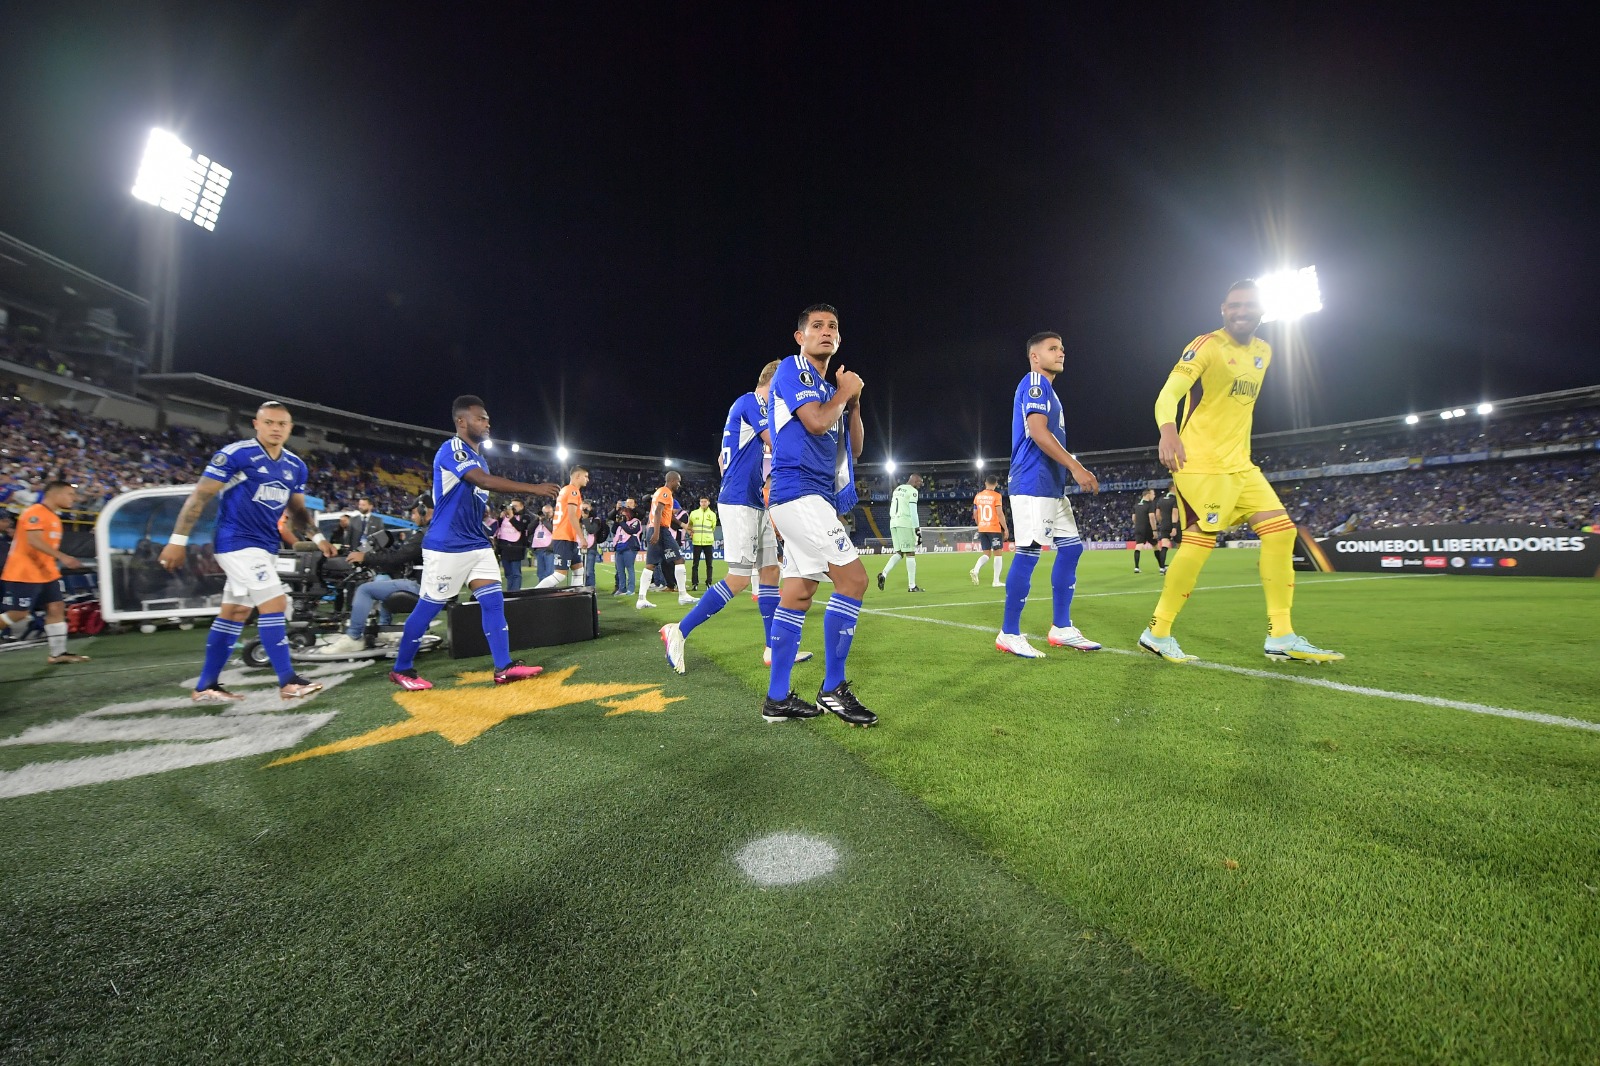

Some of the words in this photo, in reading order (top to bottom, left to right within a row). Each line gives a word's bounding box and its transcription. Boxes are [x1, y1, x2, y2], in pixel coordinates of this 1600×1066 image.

[978, 504, 993, 522] 10
[934, 544, 953, 553] bwin
[1336, 538, 1430, 553] CONMEBOL
[1433, 536, 1585, 552] LIBERTADORES
